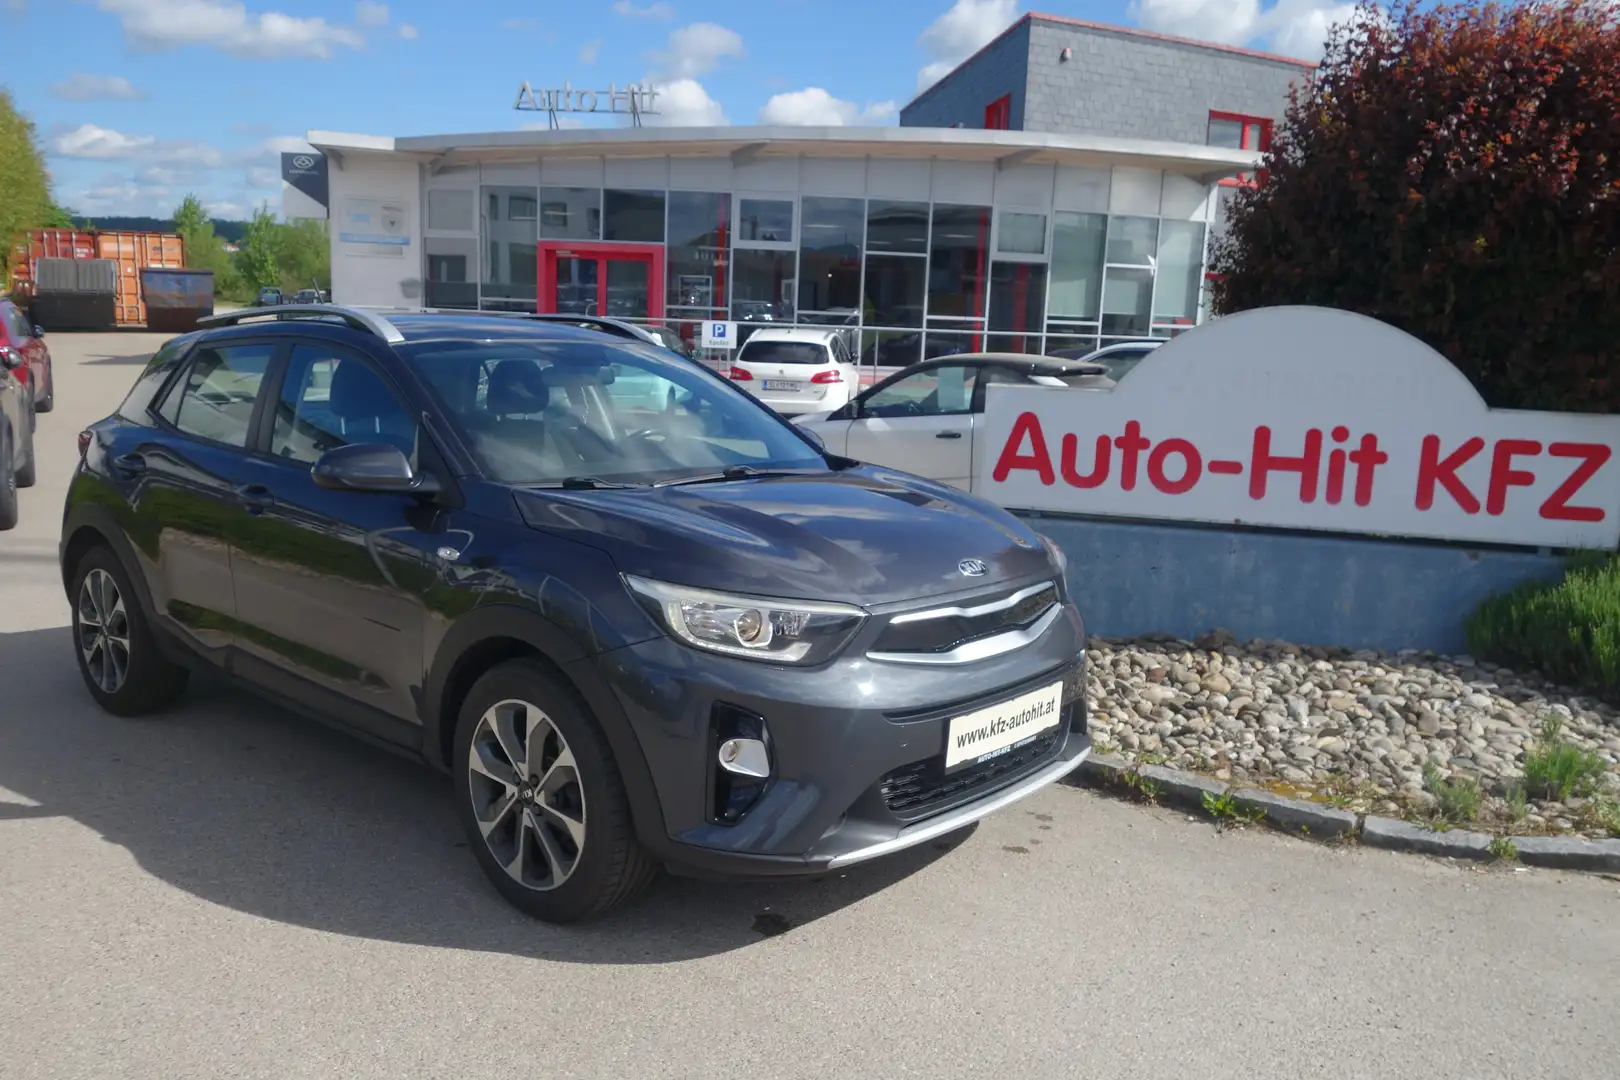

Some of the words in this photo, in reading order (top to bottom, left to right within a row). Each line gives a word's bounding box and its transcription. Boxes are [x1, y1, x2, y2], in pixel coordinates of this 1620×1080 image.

[513, 80, 597, 112] Auto
[609, 81, 660, 113] Hit
[714, 324, 724, 337] P
[992, 411, 1388, 507] Auto-Hit
[1415, 433, 1612, 522] KFZ
[956, 696, 1055, 749] www.kfz-autohit.at
